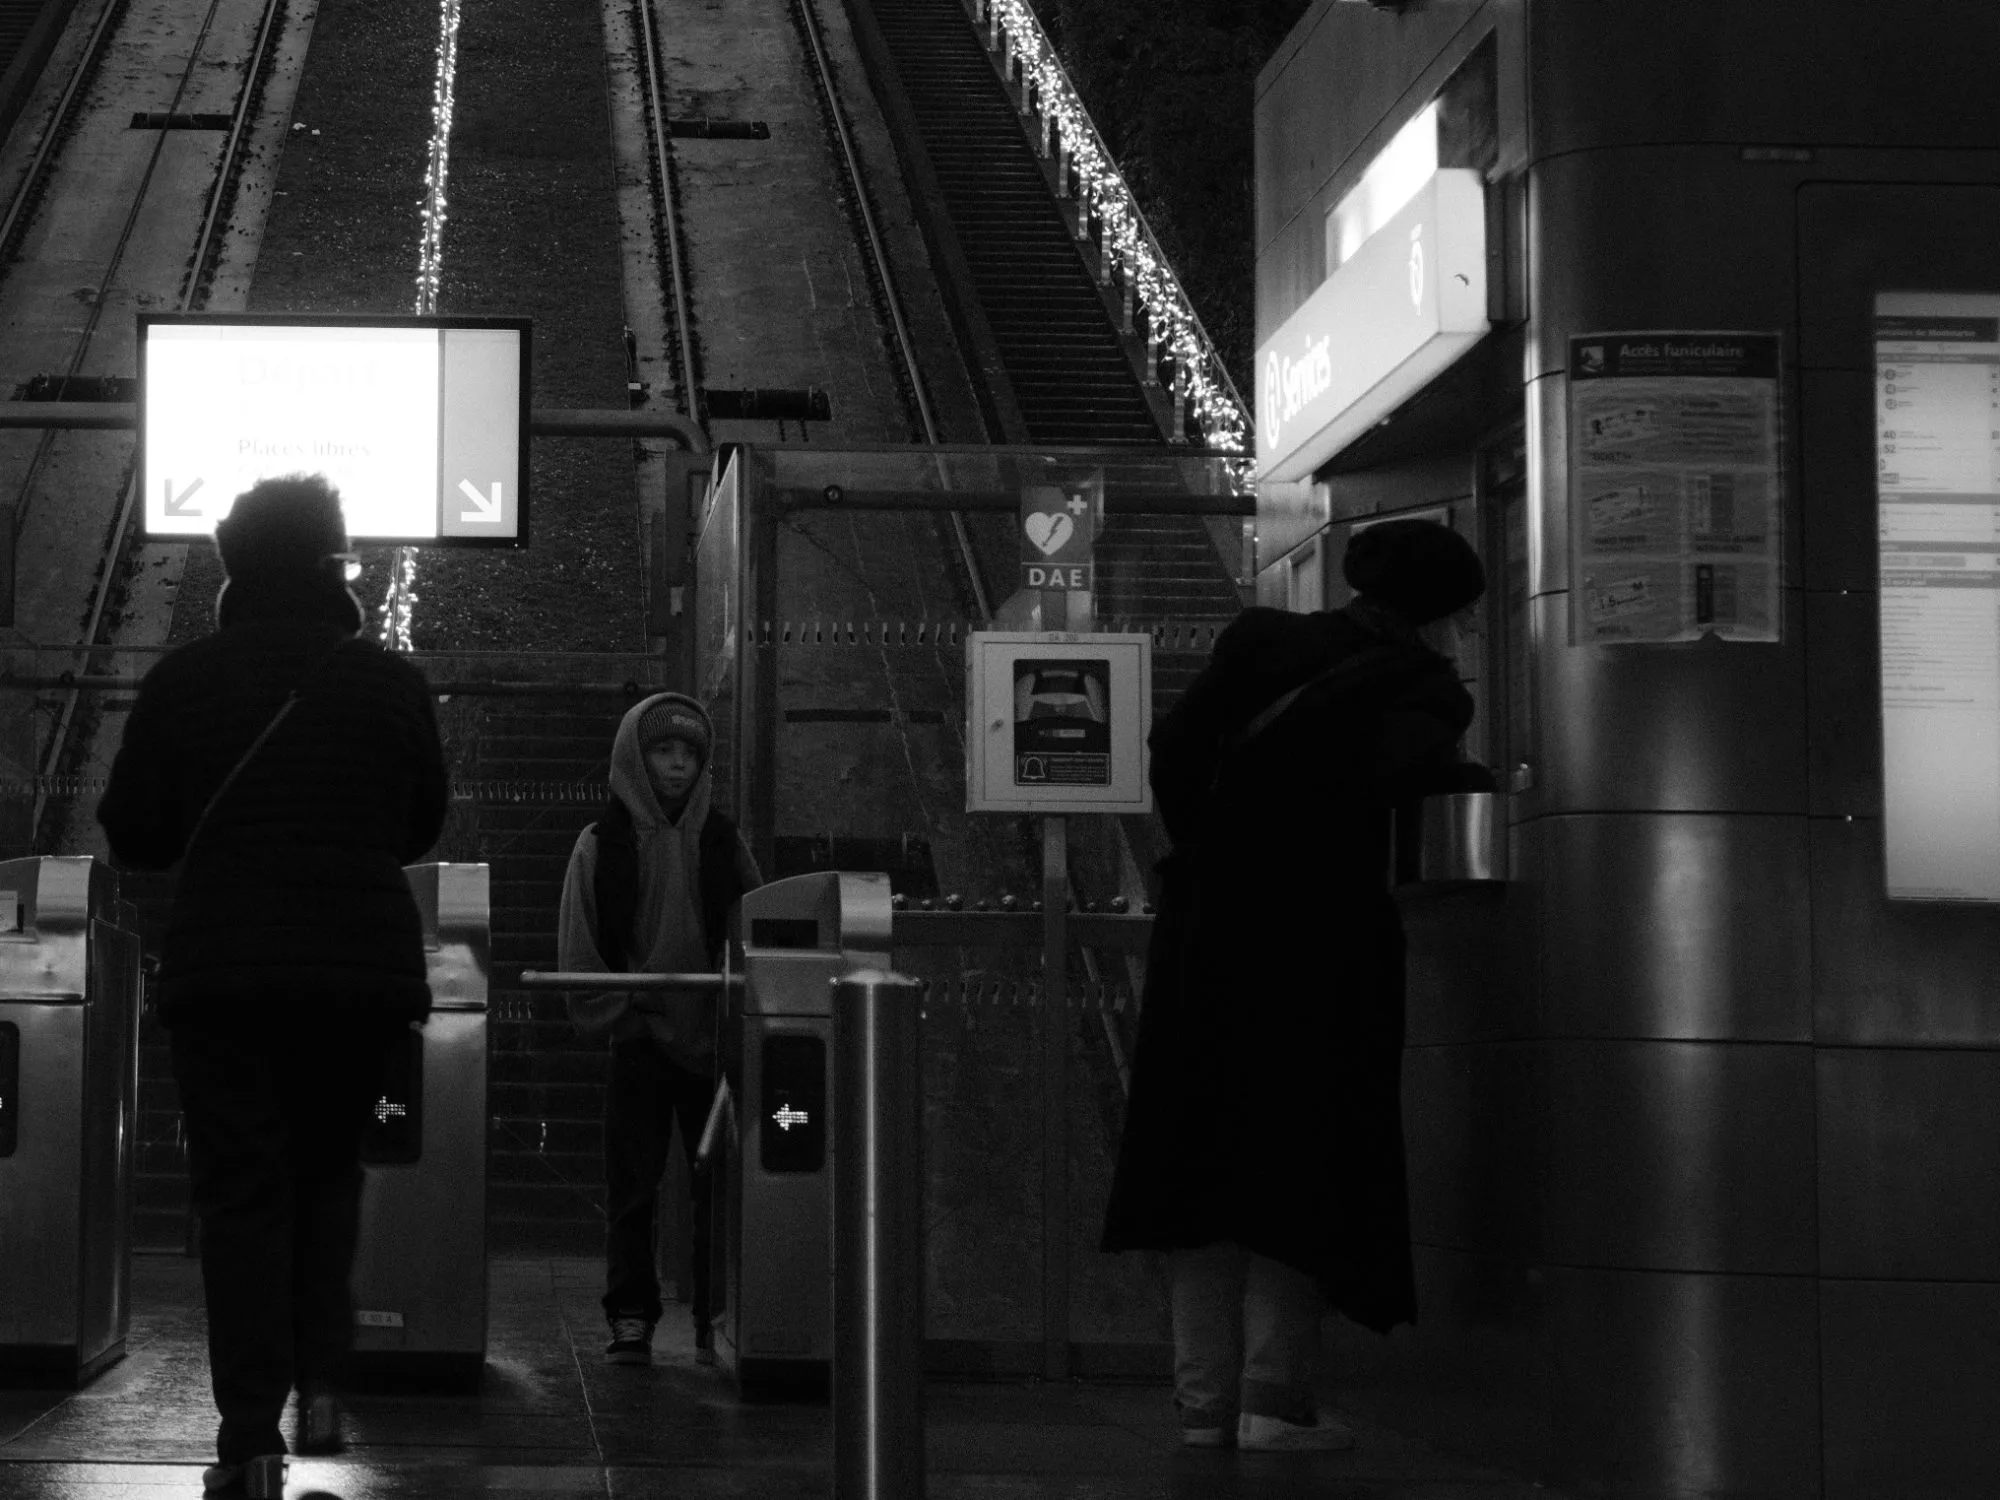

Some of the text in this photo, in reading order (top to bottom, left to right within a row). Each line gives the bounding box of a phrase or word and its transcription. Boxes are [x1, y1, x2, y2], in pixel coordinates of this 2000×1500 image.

[1619, 343, 1745, 358] Accès funiculaire
[1282, 334, 1330, 421] Services
[239, 440, 371, 457] Places libres
[1029, 568, 1083, 587] DAE
